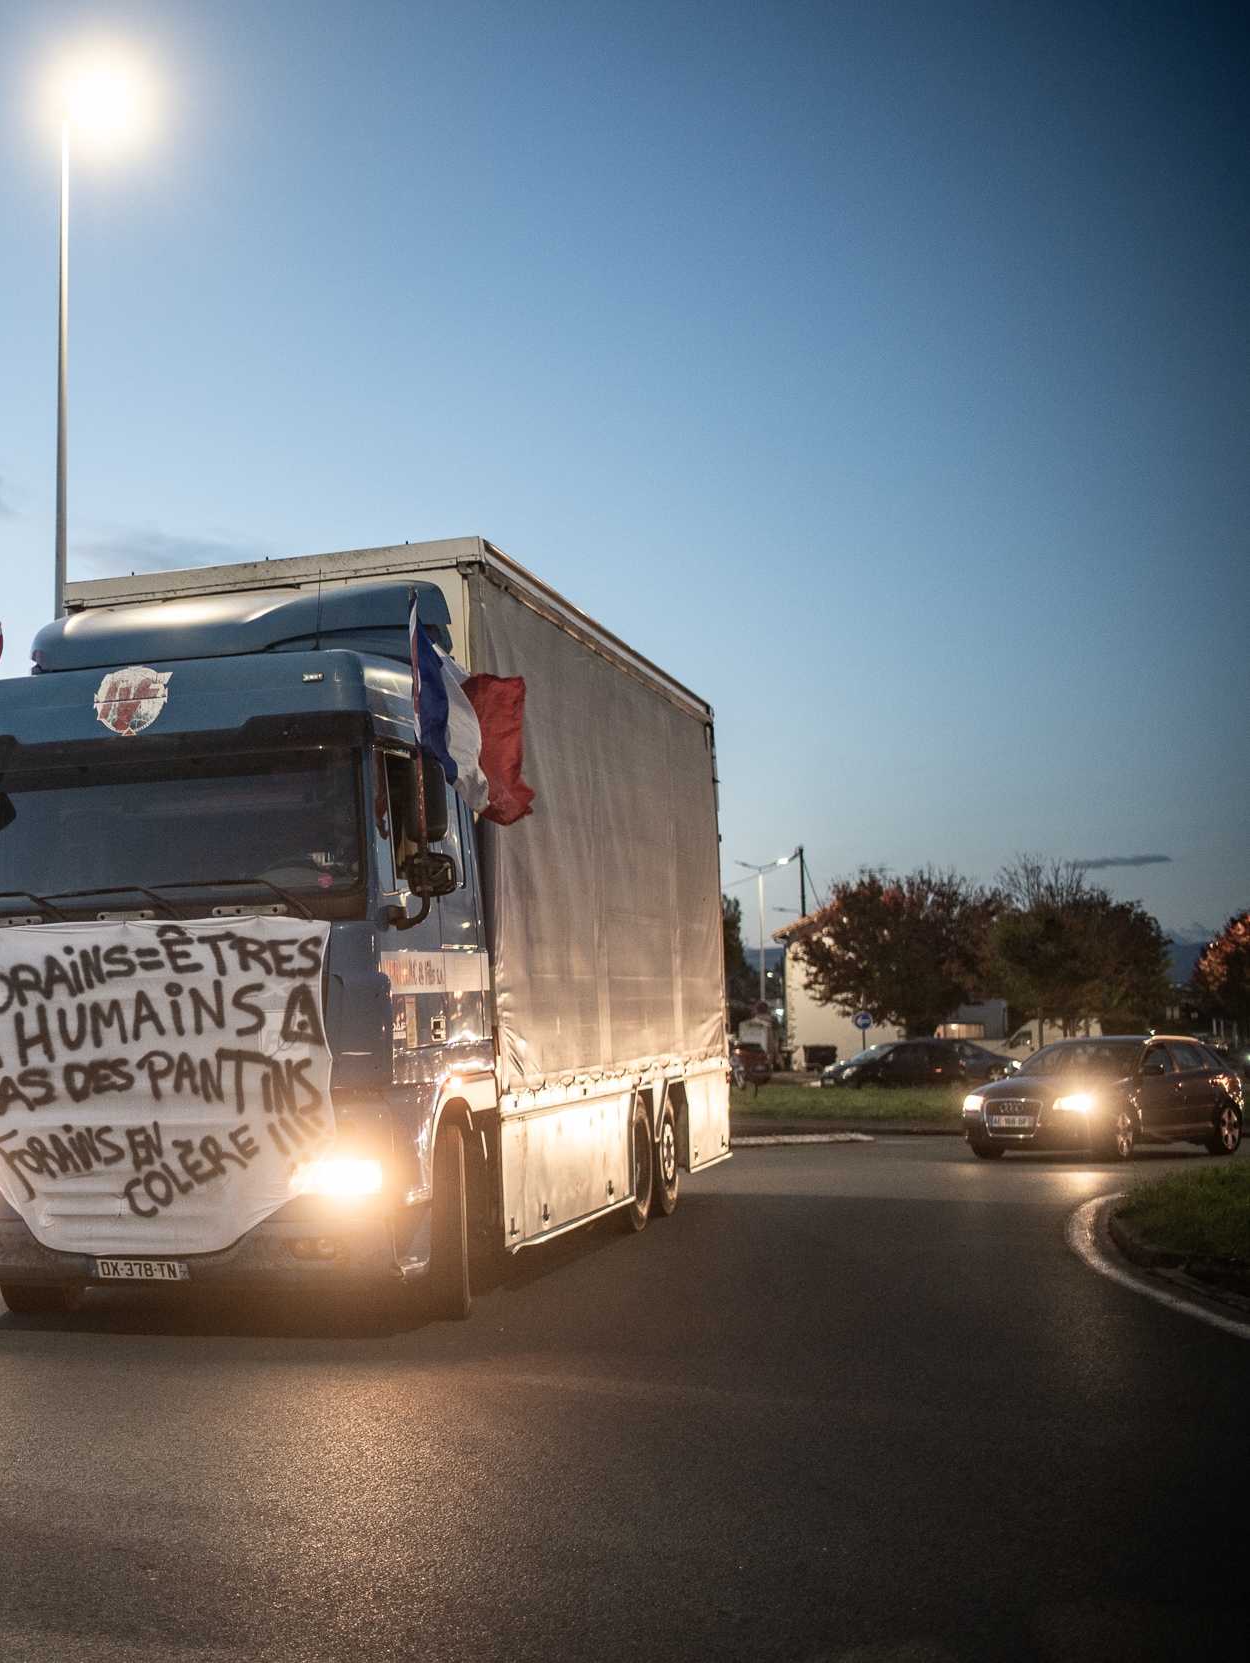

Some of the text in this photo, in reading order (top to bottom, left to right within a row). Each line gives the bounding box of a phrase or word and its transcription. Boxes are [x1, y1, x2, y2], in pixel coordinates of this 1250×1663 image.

[64, 1057, 135, 1103] DES
[136, 1047, 323, 1115] PANTINS
[125, 1121, 164, 1171] EN
[100, 1261, 178, 1278] DX-378-TN
